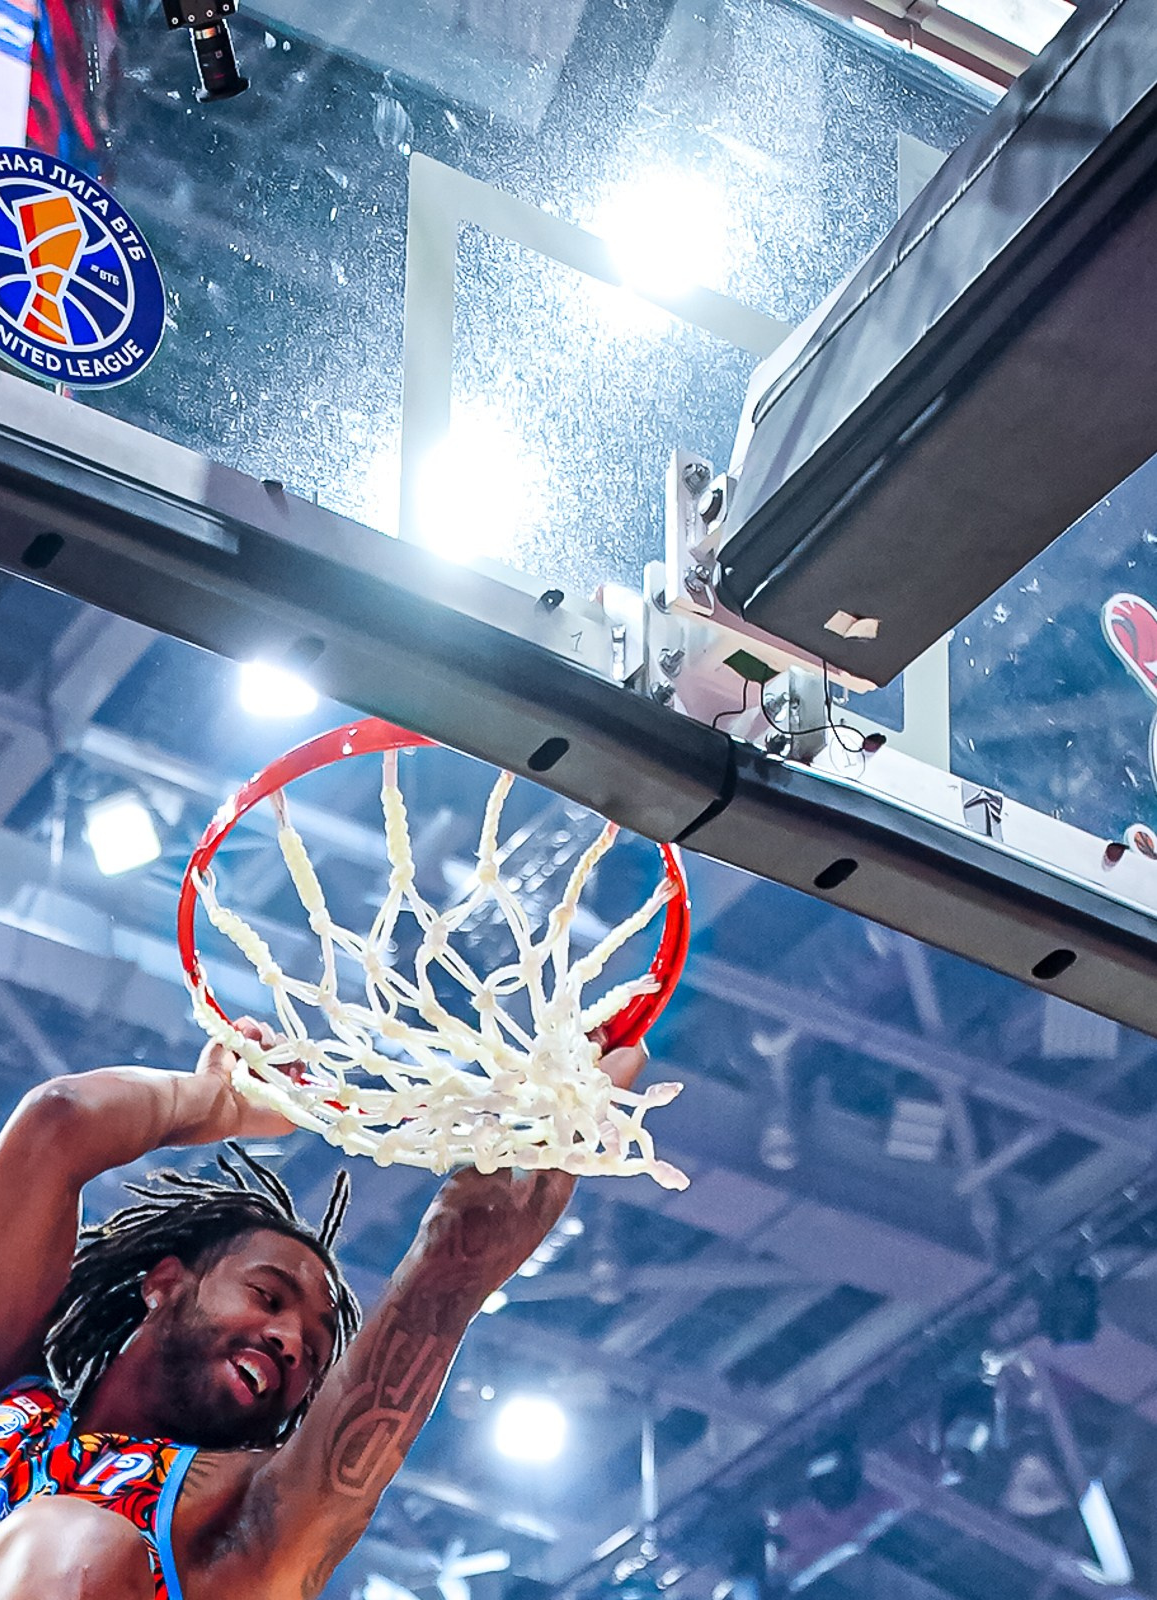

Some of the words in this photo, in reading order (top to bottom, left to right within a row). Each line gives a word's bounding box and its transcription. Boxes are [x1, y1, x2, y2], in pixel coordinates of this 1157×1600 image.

[49, 165, 109, 217] ЛИГА
[110, 217, 146, 262] ВТБ
[99, 269, 120, 287] ВТБ
[65, 338, 144, 377] LEAGUE
